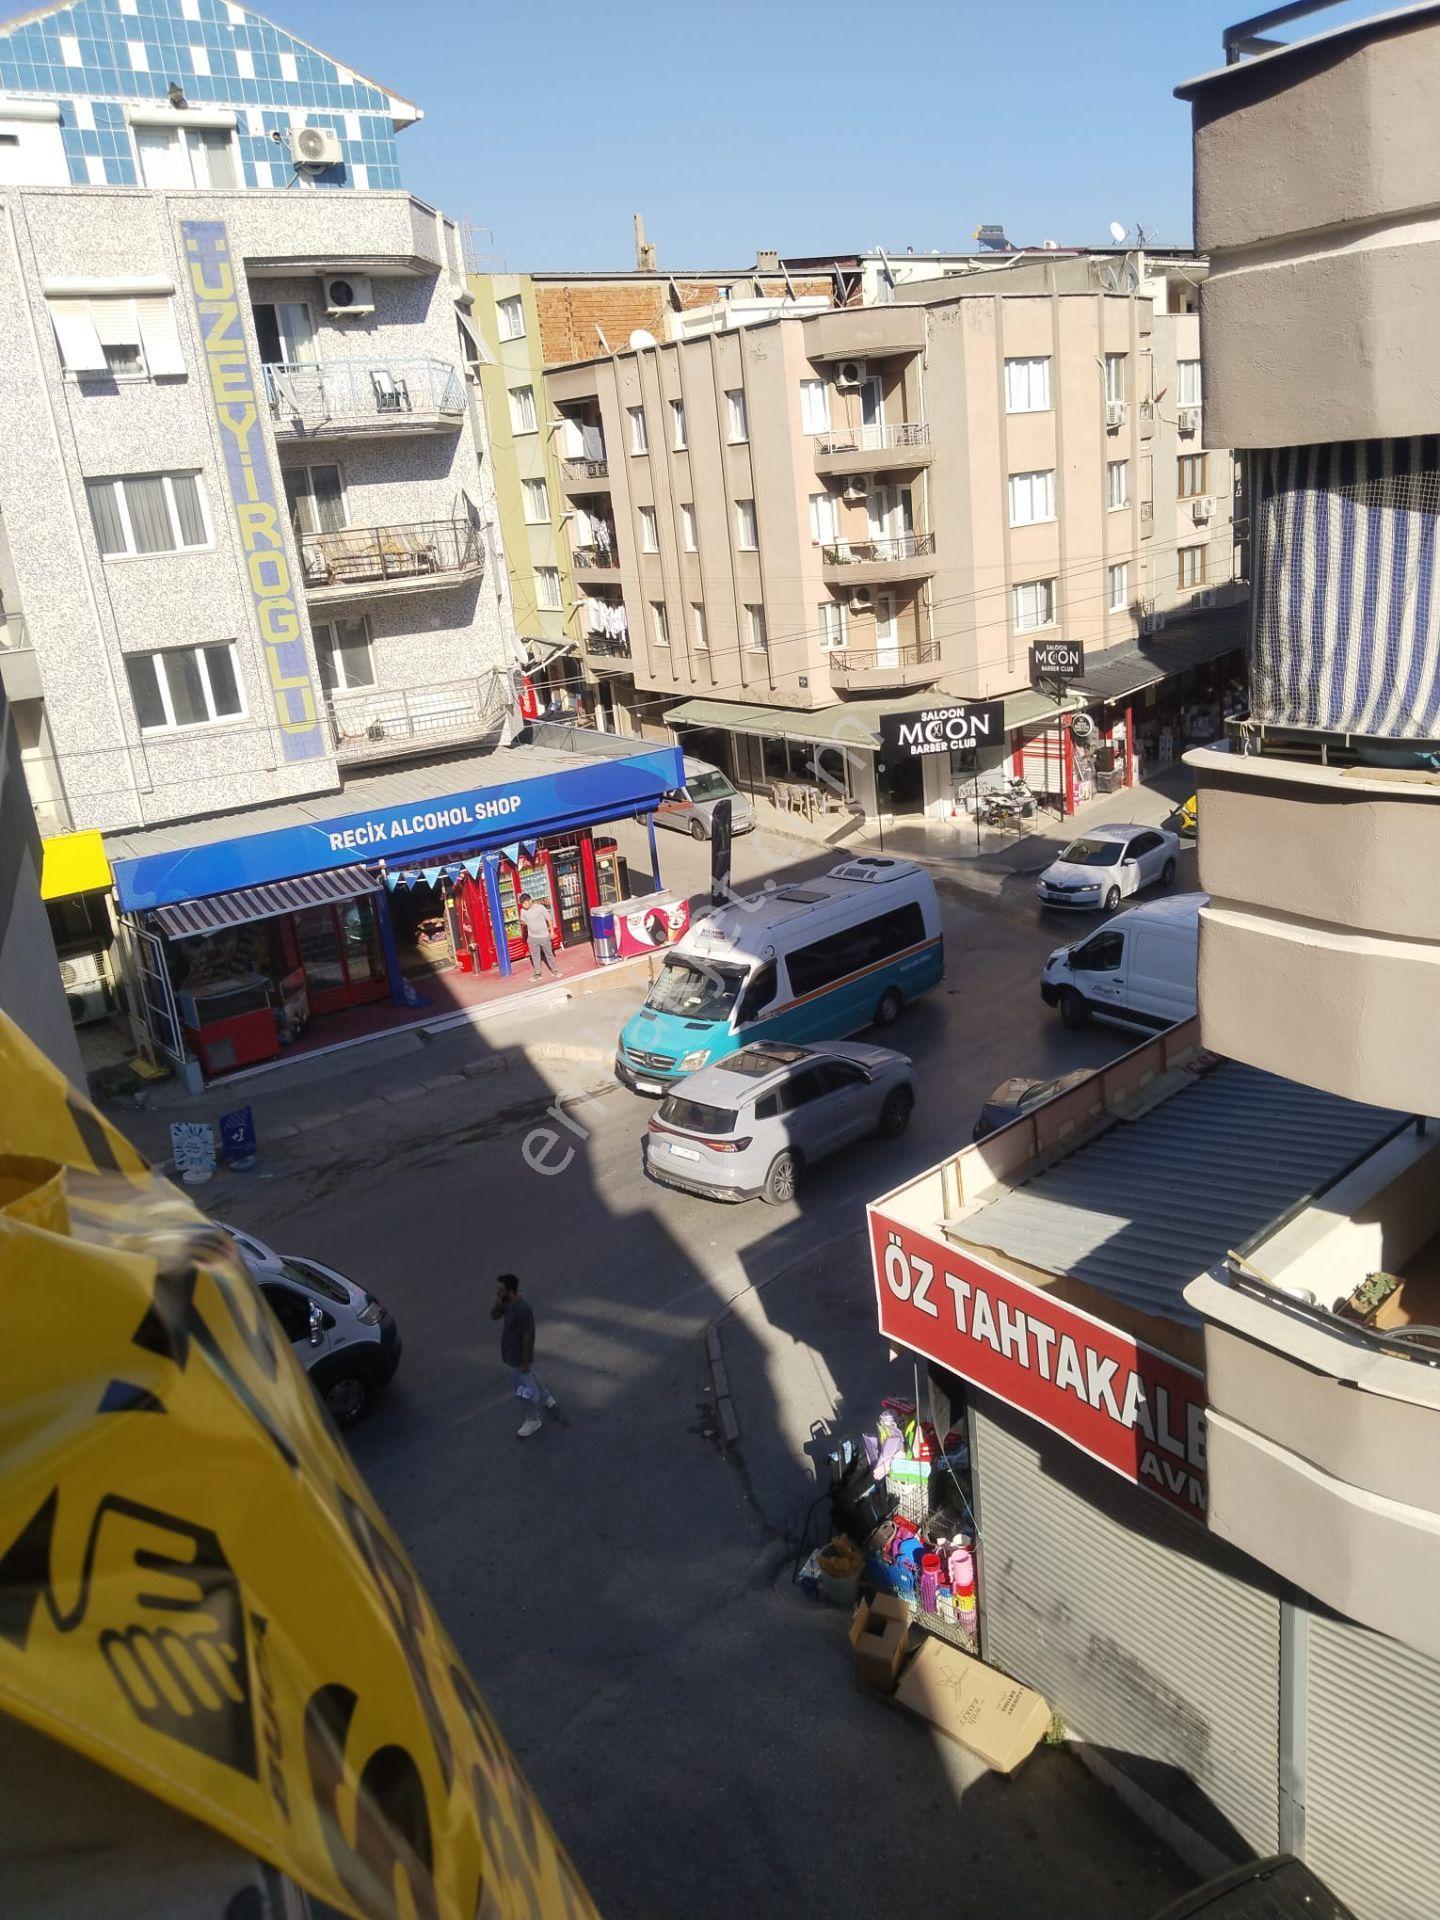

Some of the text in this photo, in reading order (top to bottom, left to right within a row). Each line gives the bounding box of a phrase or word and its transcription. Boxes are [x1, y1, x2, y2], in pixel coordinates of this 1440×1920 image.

[921, 707, 965, 722] SALOON
[910, 738, 977, 755] BARBER CLUB
[329, 795, 521, 851] RECİX ALCOHOL SHOP
[884, 1231, 1207, 1474] ÖZ TAHTAKALE
